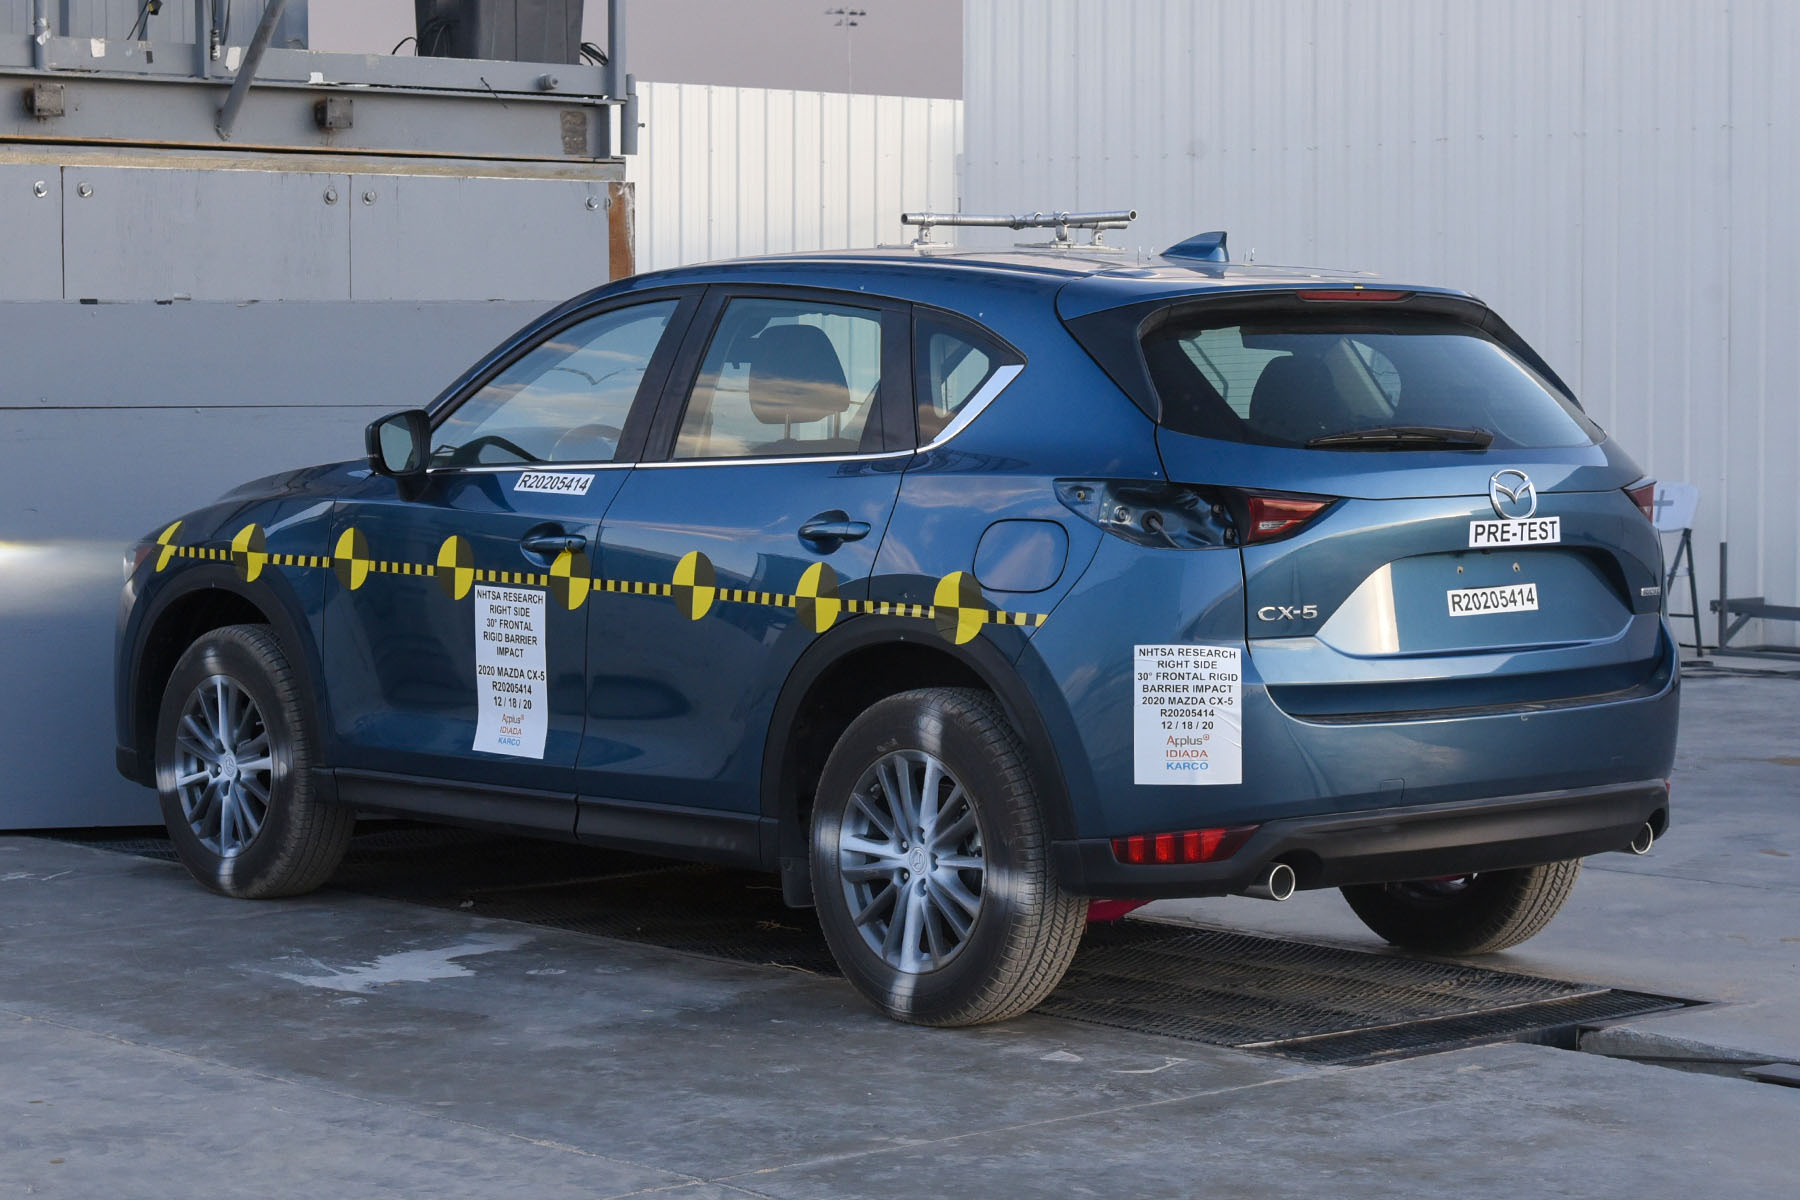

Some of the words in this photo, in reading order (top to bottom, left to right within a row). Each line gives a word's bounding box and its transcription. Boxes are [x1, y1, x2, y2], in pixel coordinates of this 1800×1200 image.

[519, 475, 590, 491] R20205414
[1475, 521, 1557, 543] PRE-TEST
[477, 590, 501, 601] NHTSA
[503, 592, 543, 604] RESEARCH
[1452, 587, 1534, 612] R20205414
[490, 605, 511, 615] RIGHT
[514, 607, 530, 617] SIDE
[1258, 605, 1317, 620] CX-5
[500, 619, 533, 631] FRONTAL
[484, 631, 502, 642] RIGID
[505, 633, 537, 645] BARRIER
[497, 647, 524, 658] IMPACT
[1139, 648, 1174, 656] NHTSA
[1178, 649, 1236, 659] RESEARCH
[1158, 660, 1190, 668] RIGHT
[1193, 661, 1217, 669] SIDE
[478, 665, 495, 675] 2020
[498, 667, 525, 679] MAZDA
[527, 670, 545, 681] CX-5
[1209, 673, 1238, 681] RIGID
[492, 681, 532, 695] R20205414
[1143, 685, 1189, 693] BARRIER
[1193, 685, 1233, 693] IMPACT
[494, 696, 502, 706] 12
[509, 698, 517, 708] 18
[523, 700, 532, 709] 20
[1142, 697, 1164, 705] 2020
[1168, 697, 1205, 705] MAZDA
[1209, 697, 1233, 705] CX-5
[1161, 709, 1214, 717] R20205414
[500, 726, 522, 735] IDIADA
[1162, 721, 1172, 729] 12
[498, 737, 520, 746] KARCO
[1166, 750, 1208, 758] IDIADA
[1166, 762, 1208, 770] KARCO
